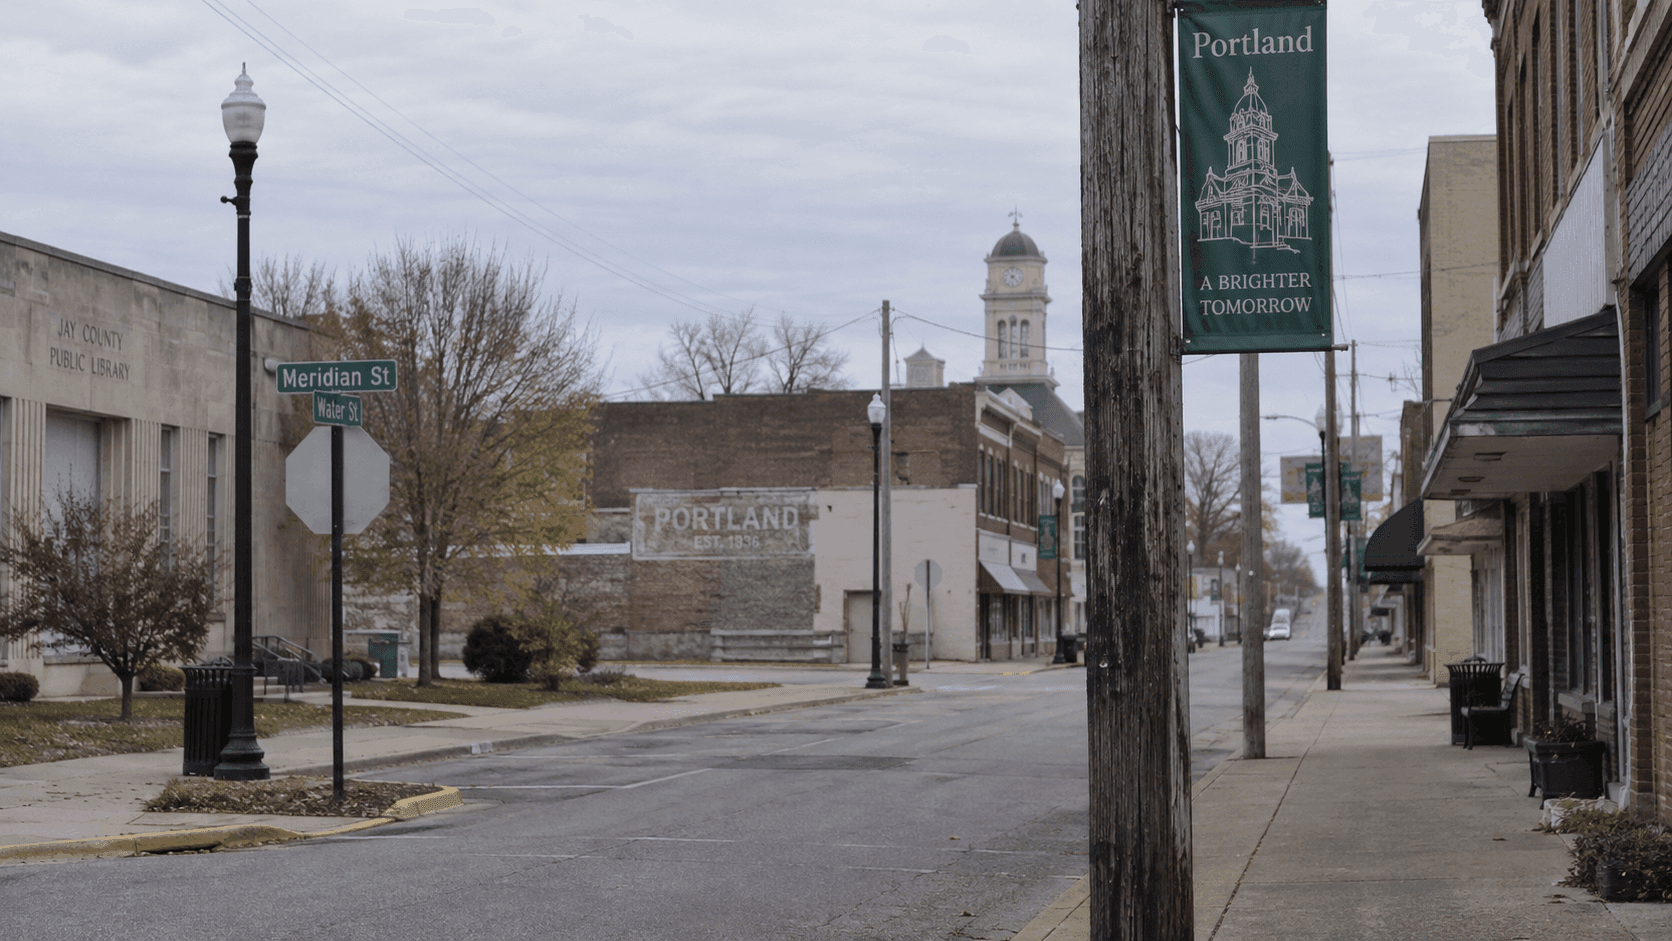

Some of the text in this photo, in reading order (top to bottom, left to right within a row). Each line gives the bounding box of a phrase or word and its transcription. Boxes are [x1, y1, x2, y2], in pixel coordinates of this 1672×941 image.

[1192, 25, 1313, 58] Portland
[1200, 272, 1312, 290] A BRIGHTER
[1200, 297, 1312, 315] TOMORROW
[57, 318, 124, 350] JAY COUNTY
[50, 346, 130, 381] PUBLIC LIBRARY
[282, 366, 390, 388] Meridian St
[316, 396, 358, 422] Water St
[654, 506, 799, 532] PORTLAND
[693, 535, 724, 550] EST.
